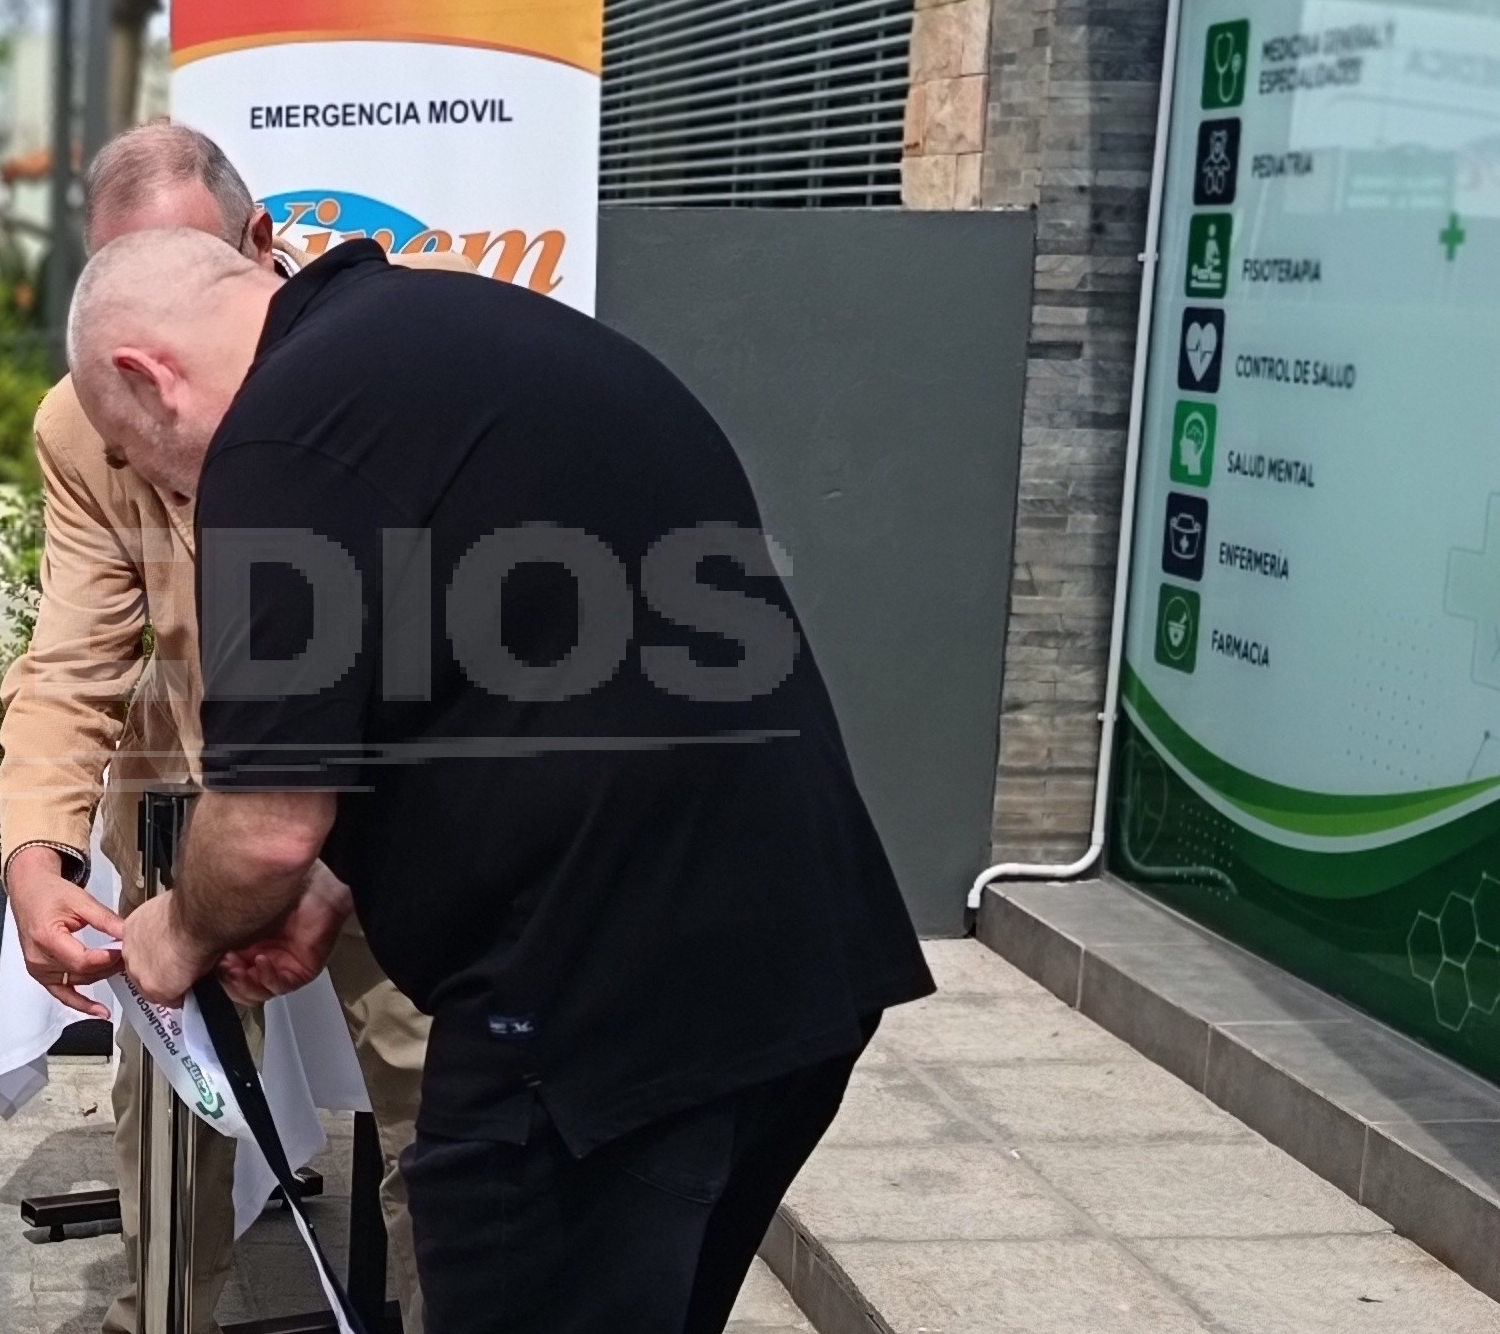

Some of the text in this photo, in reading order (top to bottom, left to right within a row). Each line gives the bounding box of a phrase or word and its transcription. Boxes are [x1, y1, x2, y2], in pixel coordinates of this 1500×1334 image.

[250, 99, 513, 129] EMERGENCIA MOVIL
[1242, 259, 1321, 283] FISIOTERAPIA
[1235, 354, 1357, 390] CONTROL DE SALUD
[1227, 450, 1315, 488] SALUD MENTAL
[1211, 629, 1270, 668] FARMACIA
